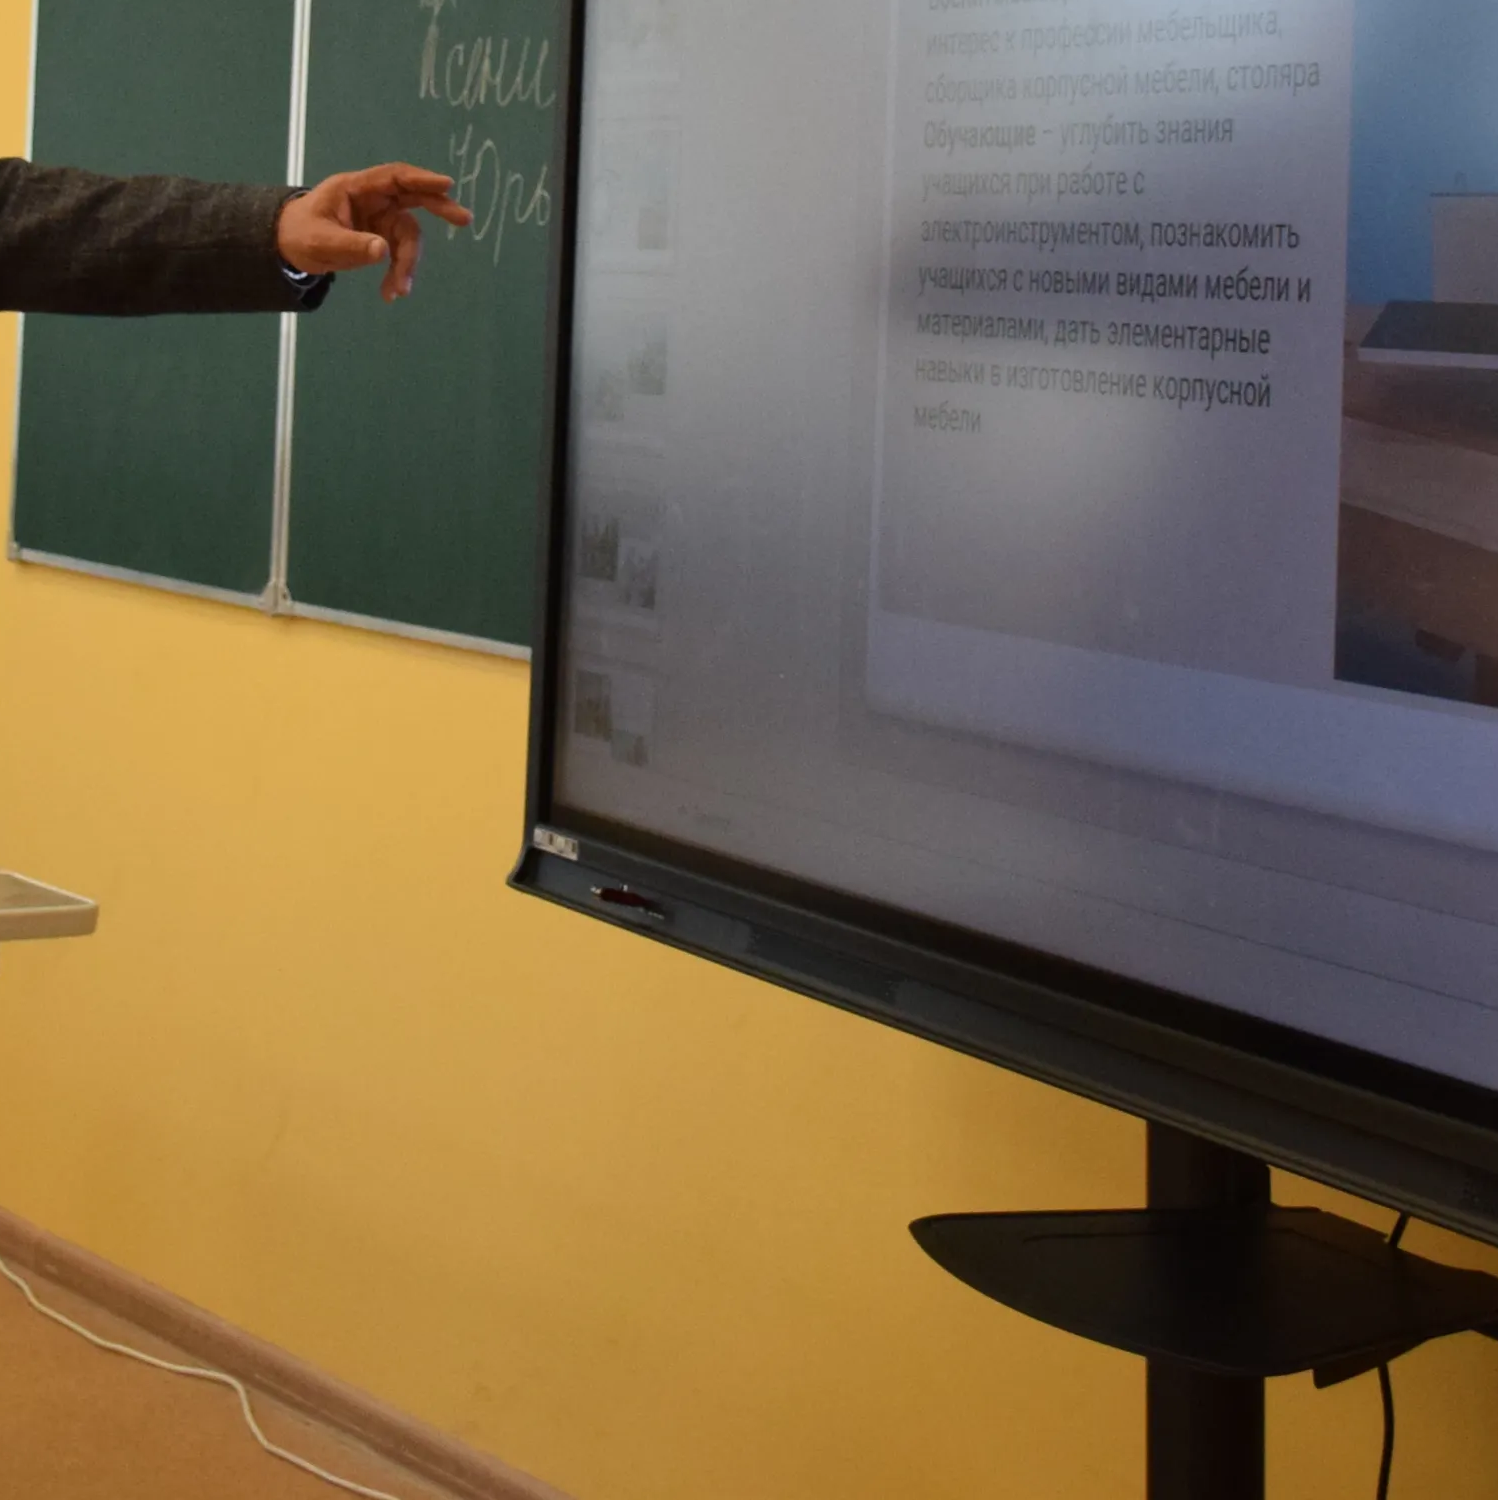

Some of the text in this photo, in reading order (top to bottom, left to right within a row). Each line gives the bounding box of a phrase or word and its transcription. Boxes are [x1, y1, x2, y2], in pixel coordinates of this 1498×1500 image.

[926, 28, 1002, 59] интерес
[1021, 17, 1133, 58] профессии
[1137, 10, 1283, 48] мебельщика,
[924, 60, 1321, 109] сборщика корпусной мебели, столяра
[923, 118, 1036, 154] Обучающие
[1059, 114, 1150, 154] углубить
[1154, 114, 1234, 145] знания
[920, 162, 1146, 205] учащихся при работе с
[920, 218, 1300, 254] электроинструментом, познакомить
[917, 267, 1312, 305] учащихся с новыми видами мебели и
[916, 312, 1272, 357] материалами, дать элементарные
[914, 357, 1272, 412] навыки в изготовление корпусной
